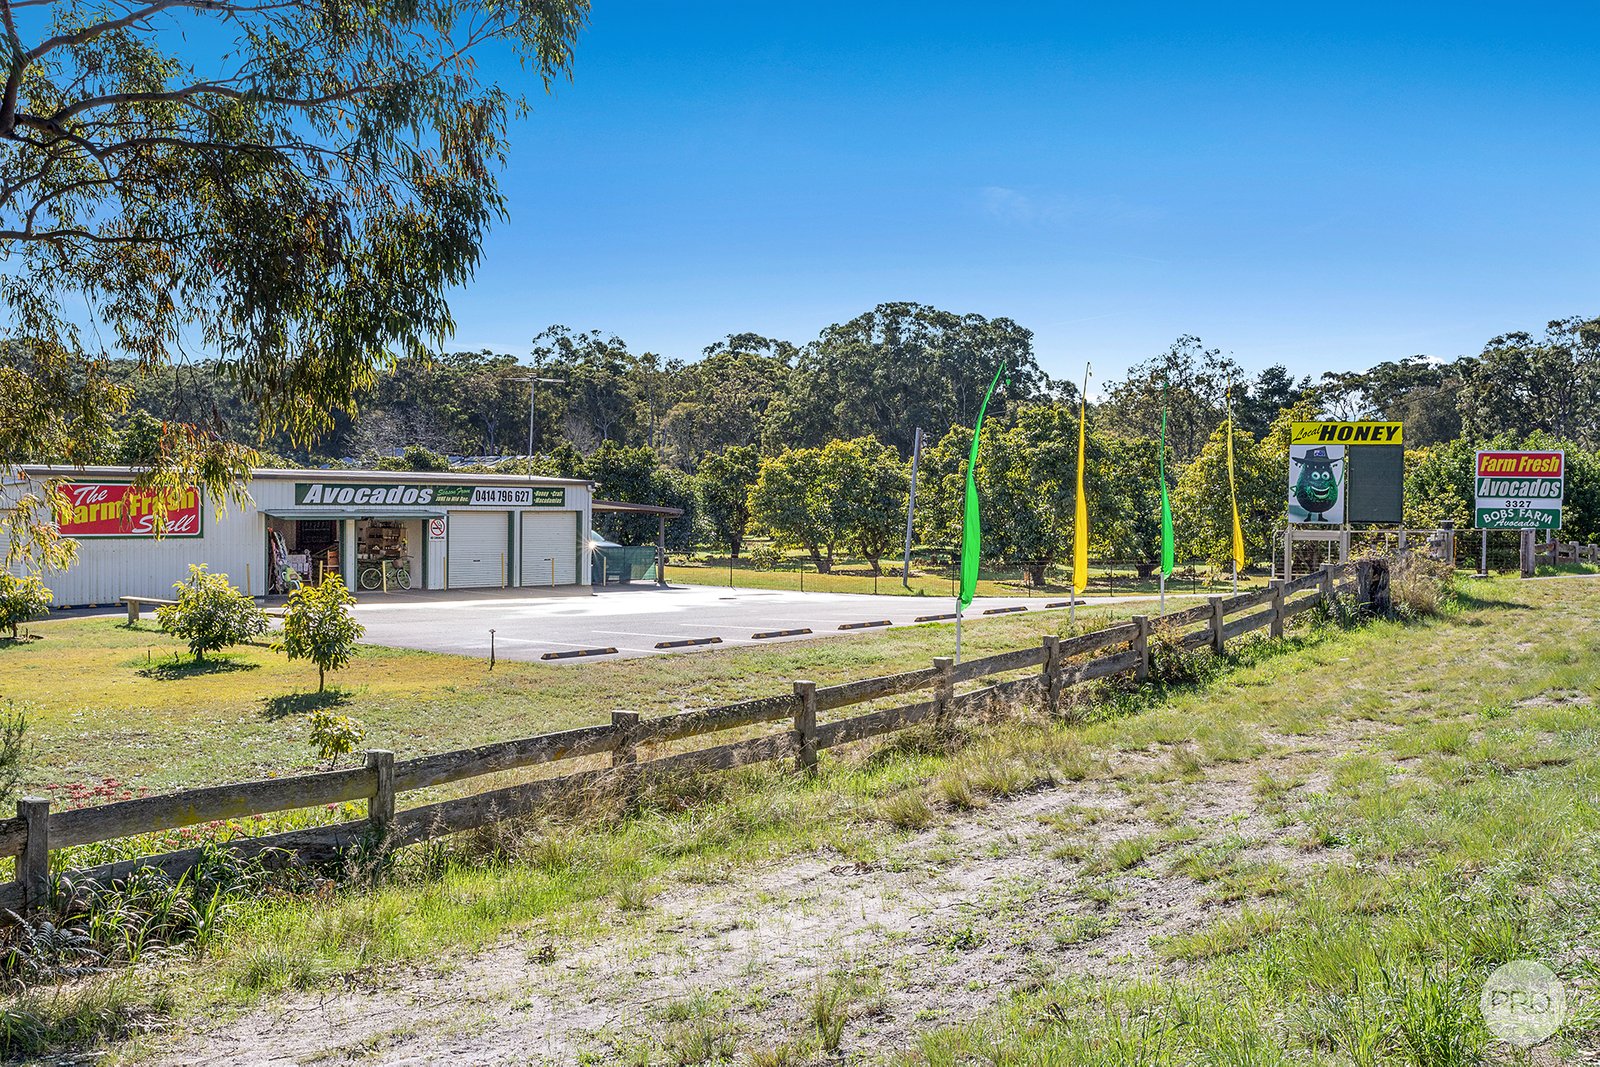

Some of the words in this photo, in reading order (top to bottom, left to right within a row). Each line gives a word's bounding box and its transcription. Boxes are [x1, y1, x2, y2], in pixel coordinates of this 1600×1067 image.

[1292, 424, 1322, 442] Local
[1318, 425, 1401, 442] HONEY
[1479, 456, 1517, 472] Farm
[1518, 456, 1560, 472] Fresh
[73, 485, 108, 506] The
[302, 484, 433, 504] Avocados
[475, 490, 495, 502] 0414
[497, 490, 513, 502] 796
[515, 490, 530, 503] 627
[1478, 478, 1561, 497] Avocados
[61, 500, 122, 526] arm
[1505, 500, 1532, 508] 3327
[131, 514, 196, 534] Sall
[1483, 509, 1515, 523] BOBS
[1519, 509, 1553, 525] FARM
[1493, 518, 1540, 527] Avocados
